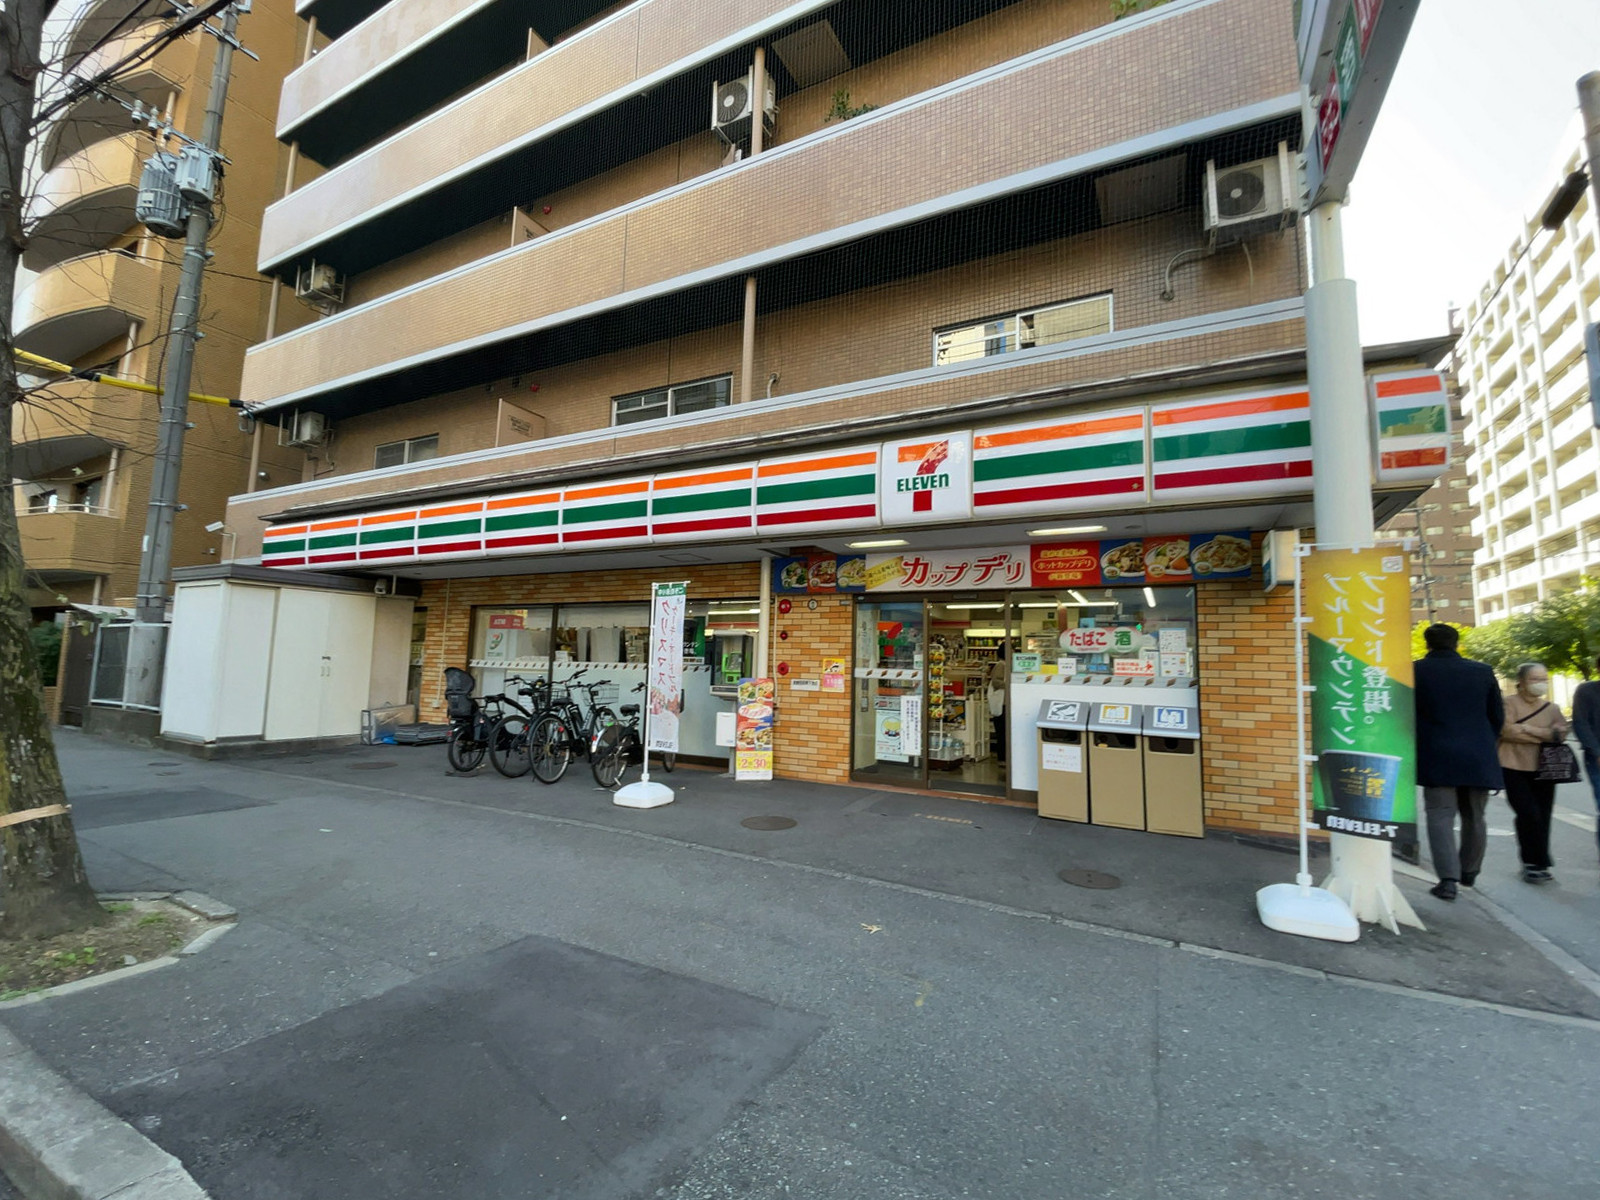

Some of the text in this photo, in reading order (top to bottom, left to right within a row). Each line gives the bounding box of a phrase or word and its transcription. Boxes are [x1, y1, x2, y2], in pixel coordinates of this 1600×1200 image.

[900, 553, 1023, 586] カップデリ
[1069, 631, 1107, 646] たばこ
[1114, 630, 1132, 646] 酒
